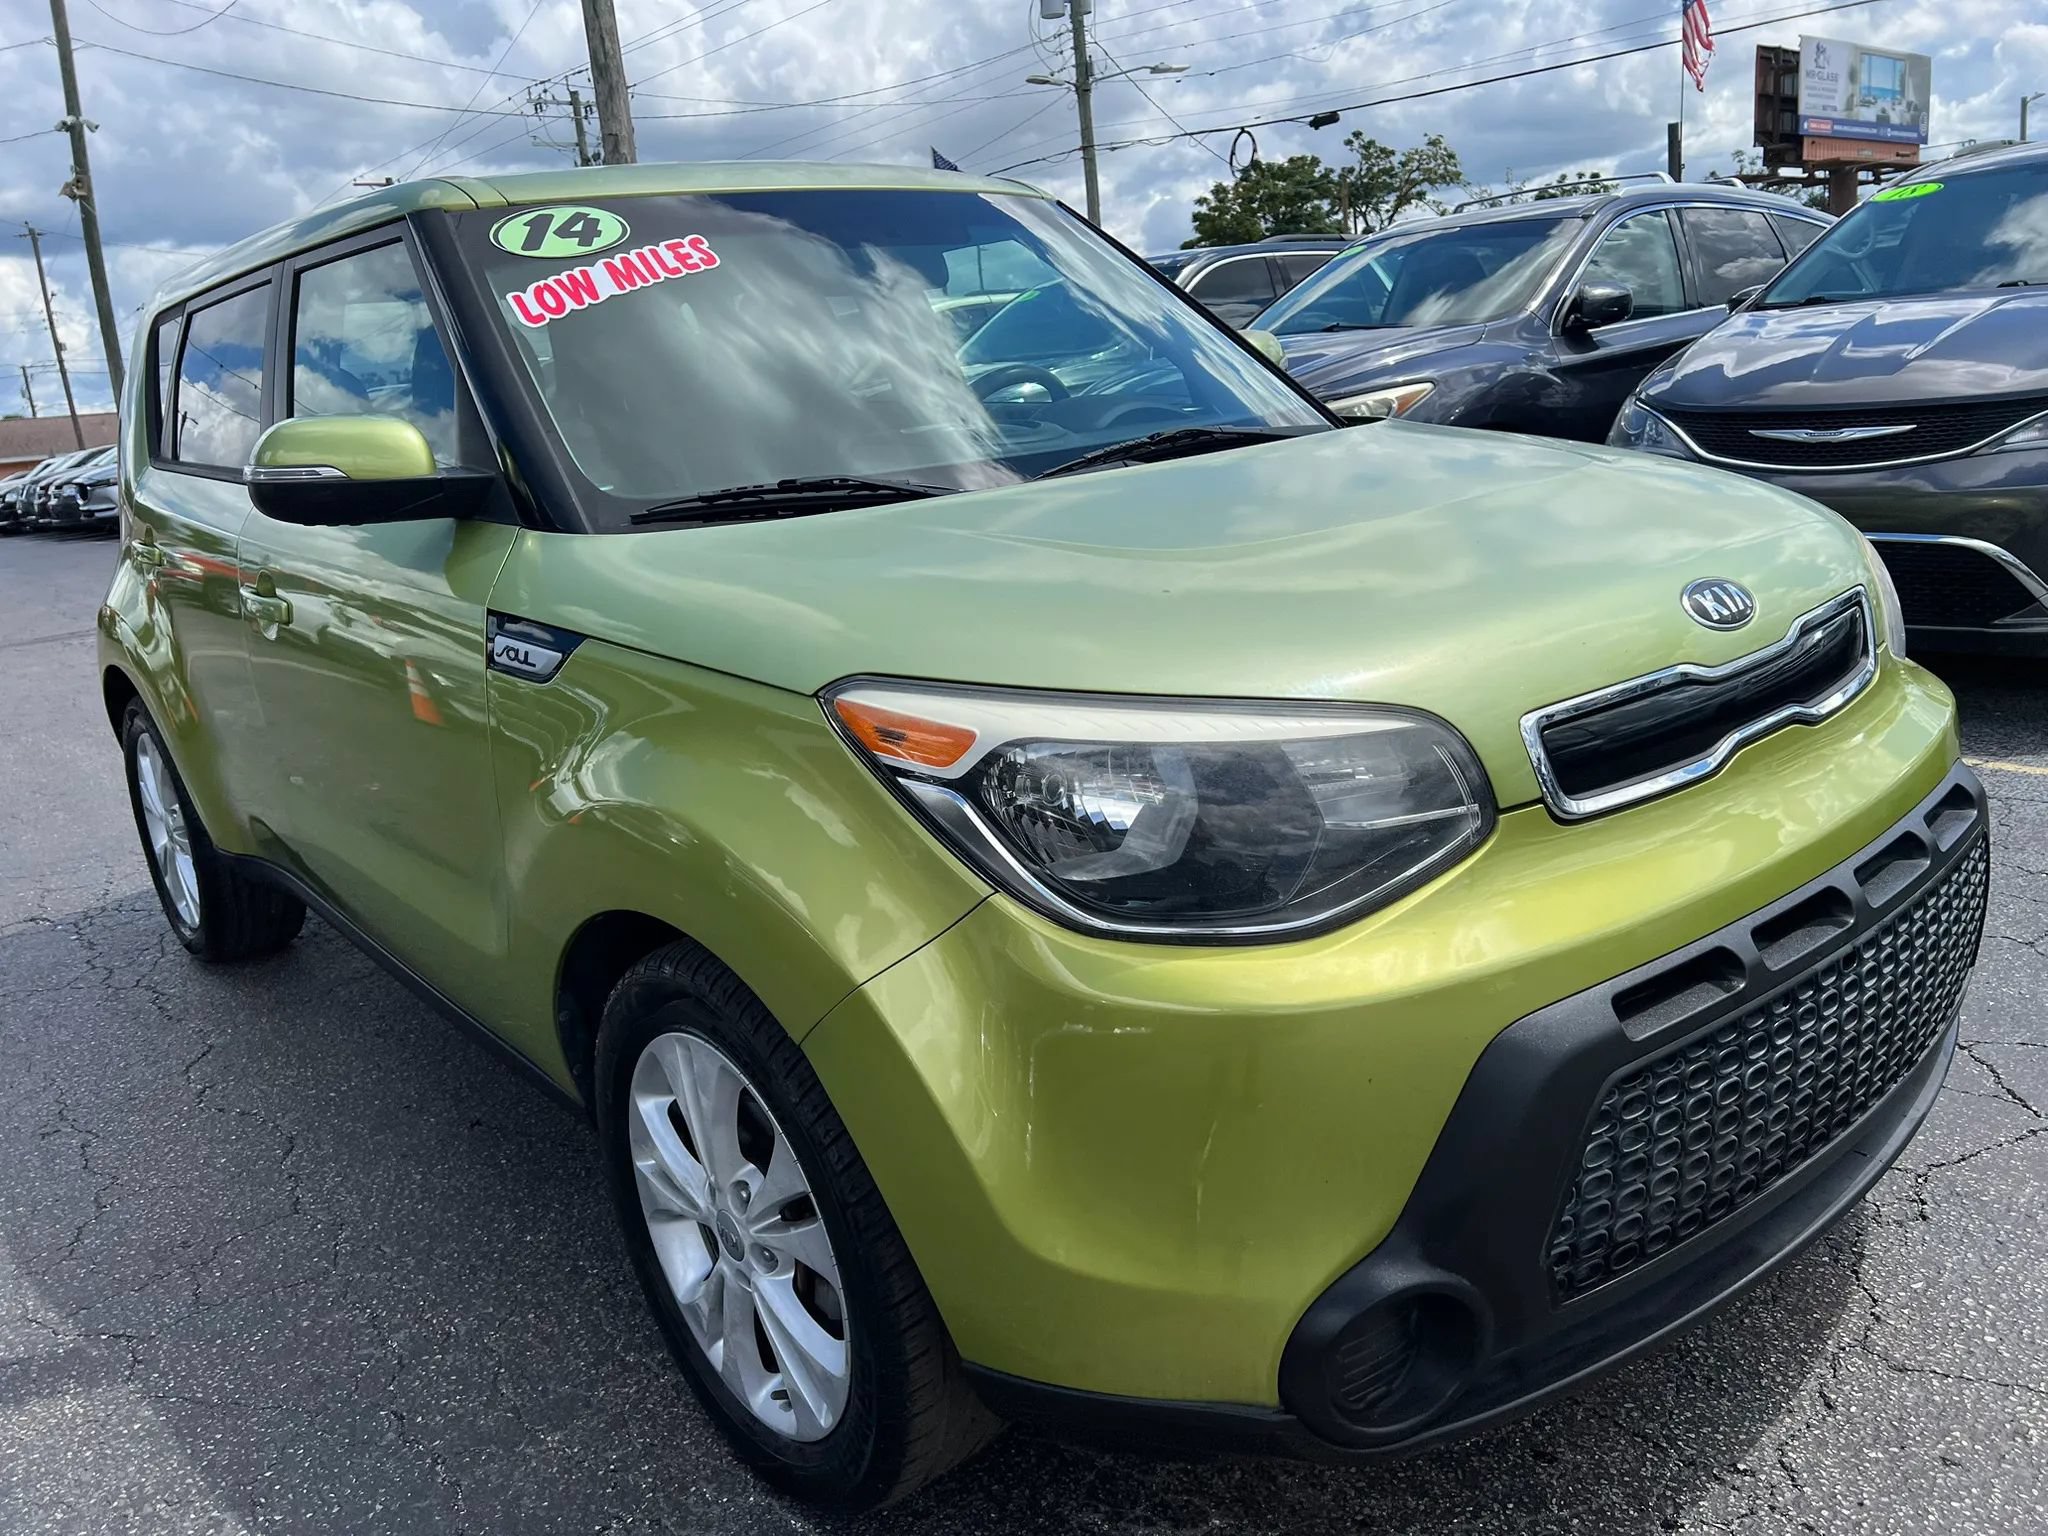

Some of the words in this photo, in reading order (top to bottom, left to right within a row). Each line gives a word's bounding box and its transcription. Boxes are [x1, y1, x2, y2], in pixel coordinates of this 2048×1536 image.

[521, 211, 602, 251] 14
[511, 268, 600, 325] LOW
[602, 236, 718, 291] MILES
[1692, 583, 1753, 621] KIA
